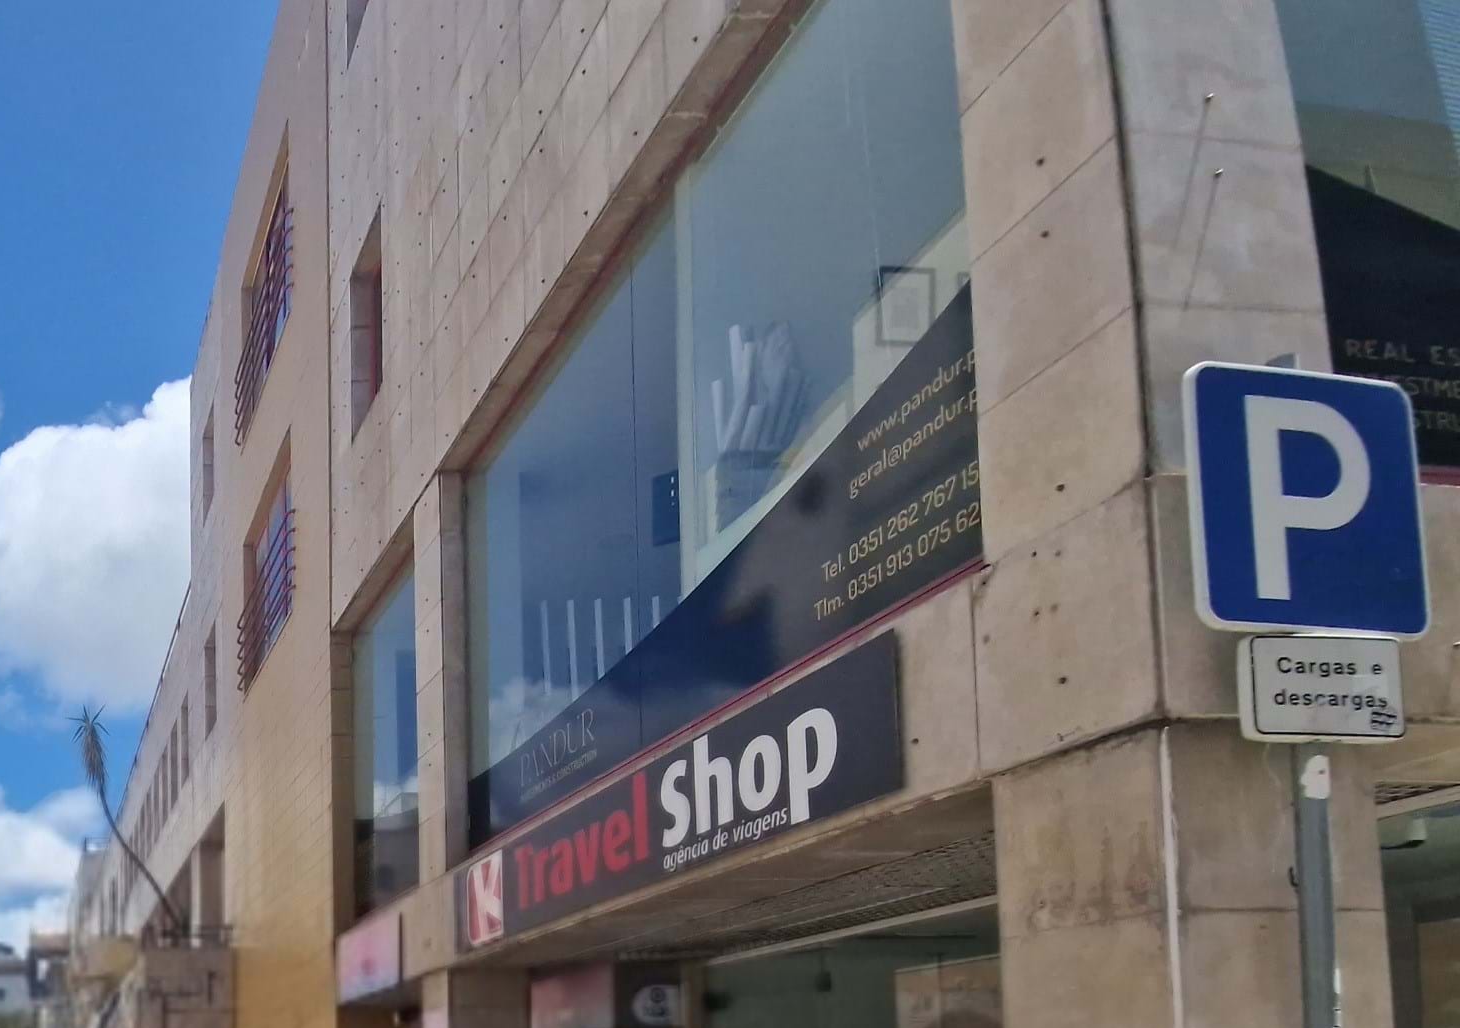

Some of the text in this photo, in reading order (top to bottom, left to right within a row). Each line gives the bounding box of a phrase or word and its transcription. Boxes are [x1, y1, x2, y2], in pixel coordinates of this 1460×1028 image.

[821, 552, 846, 582] Tel.
[848, 525, 883, 565] 0351
[887, 502, 919, 540] 262
[922, 476, 957, 516] 767
[1244, 394, 1370, 601] P
[813, 501, 980, 621] Tlm. 0351 913 075 62
[1273, 688, 1388, 711] descargas
[1276, 656, 1383, 677] Cargas e
[514, 770, 649, 911] Travel
[660, 707, 838, 848] Shop
[663, 807, 788, 872] agência de viagens
